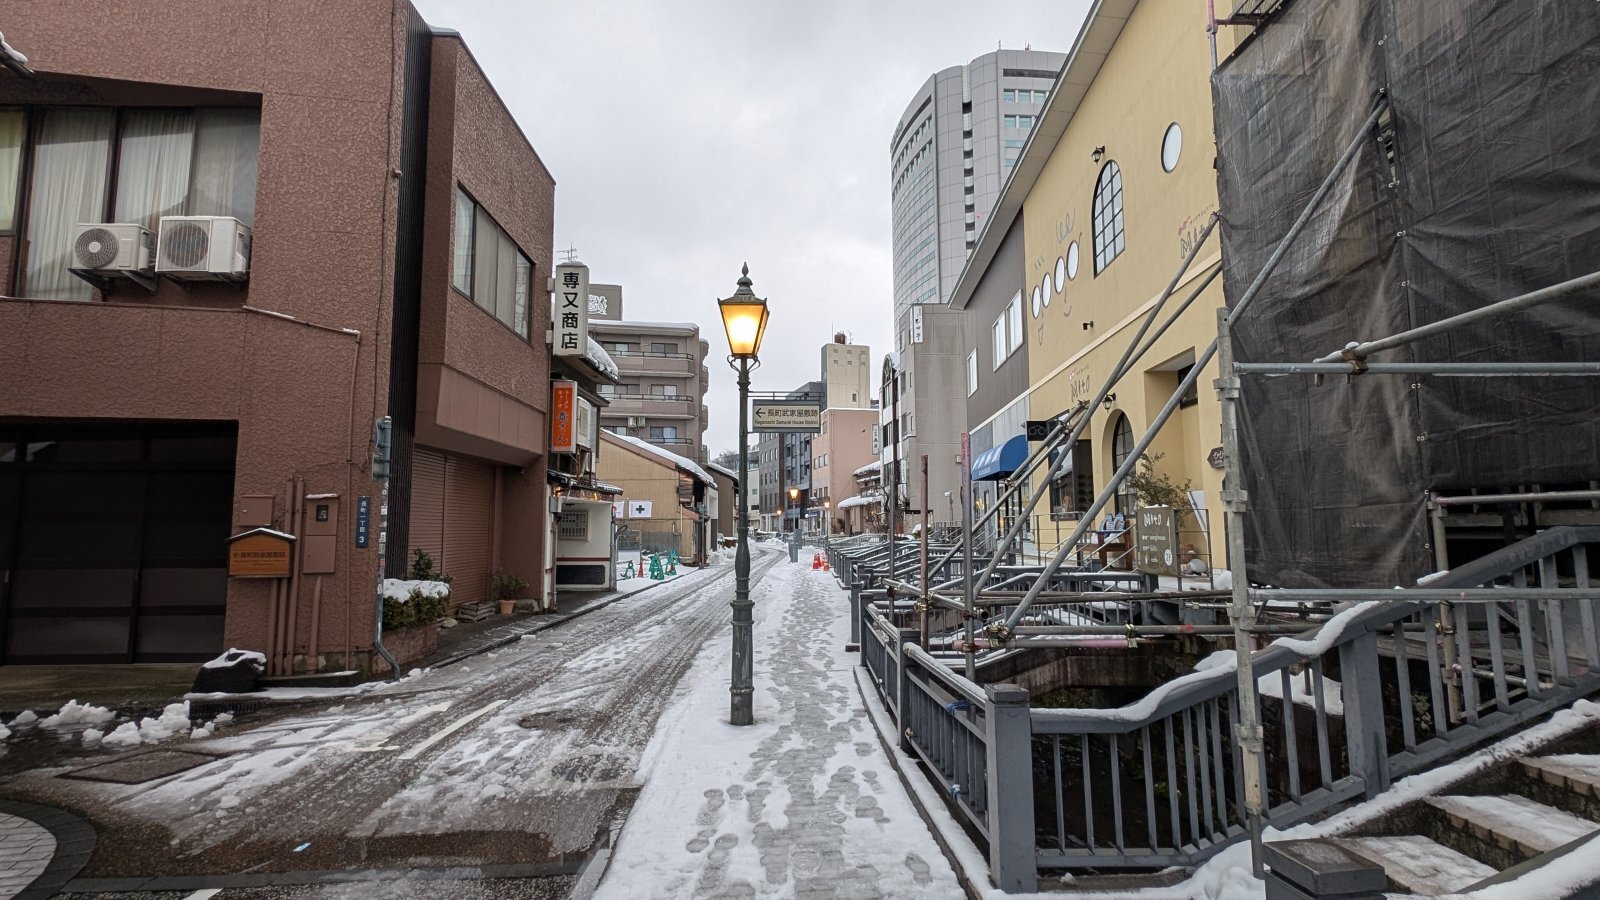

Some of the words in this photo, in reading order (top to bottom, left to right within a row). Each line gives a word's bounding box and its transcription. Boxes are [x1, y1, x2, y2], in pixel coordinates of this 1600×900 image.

[561, 271, 580, 349] 専又商店
[767, 408, 819, 417] 長町武家屋敷跡
